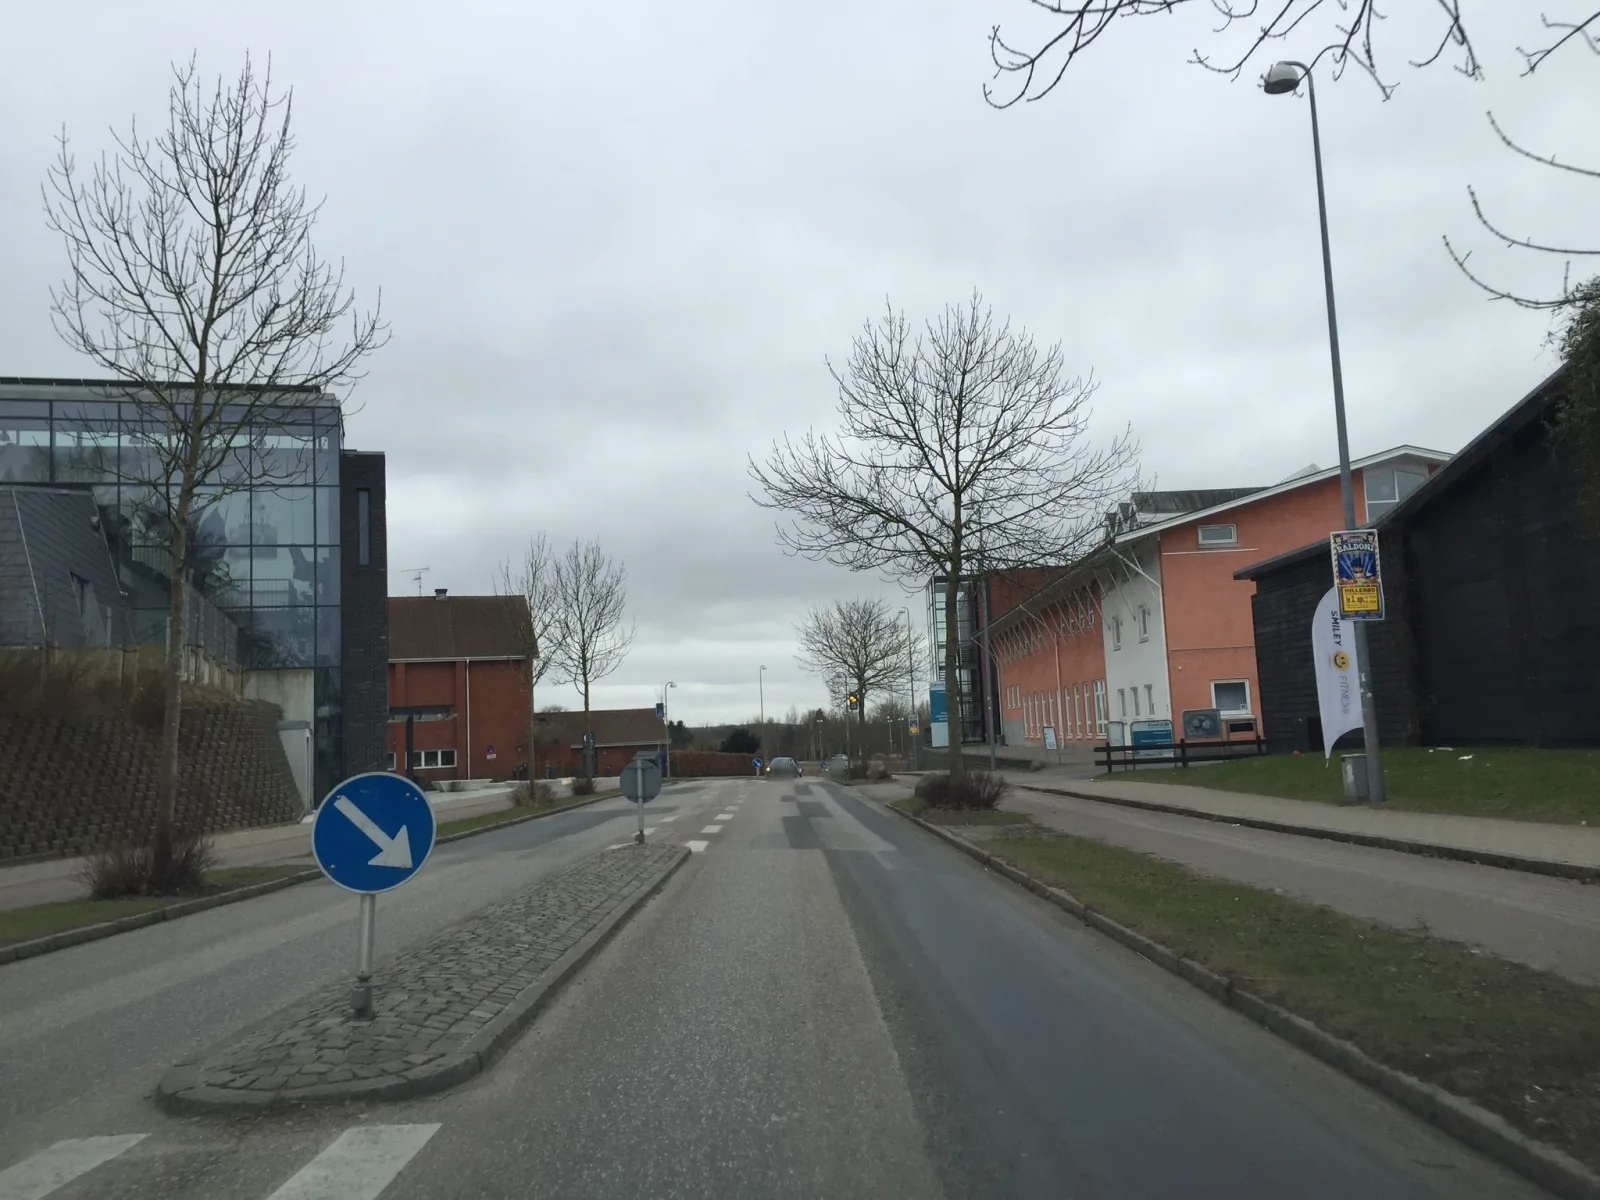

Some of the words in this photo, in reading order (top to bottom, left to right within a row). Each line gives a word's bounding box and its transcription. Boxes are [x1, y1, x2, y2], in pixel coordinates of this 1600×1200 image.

[1337, 543, 1374, 553] BALDONI
[1331, 610, 1342, 646] SMILEY
[1339, 675, 1350, 715] FITNESS
